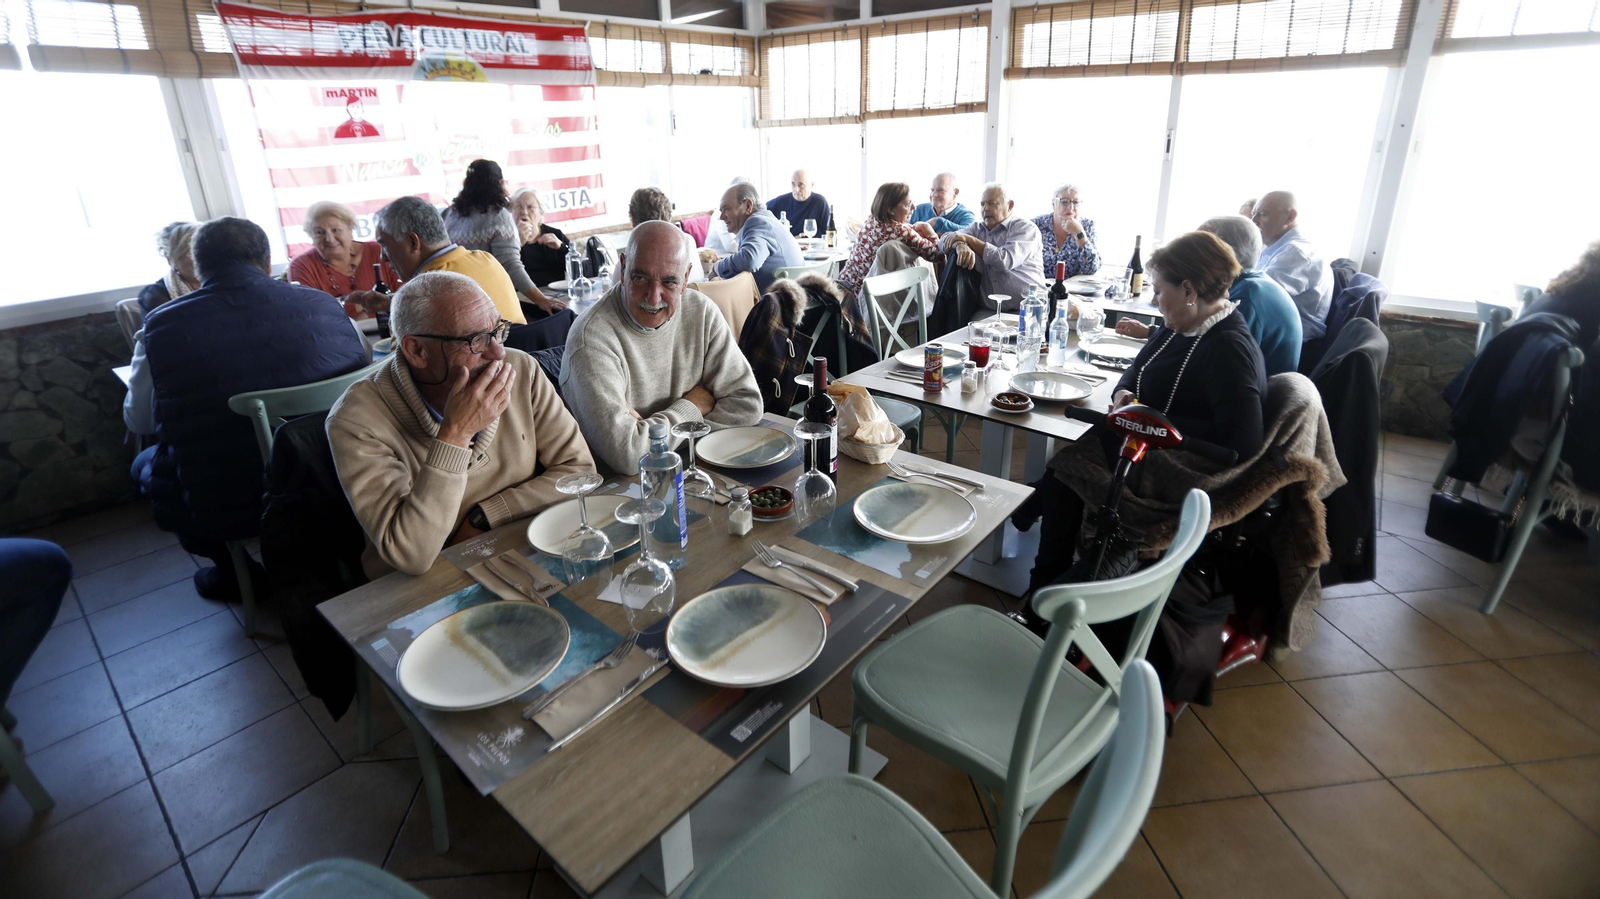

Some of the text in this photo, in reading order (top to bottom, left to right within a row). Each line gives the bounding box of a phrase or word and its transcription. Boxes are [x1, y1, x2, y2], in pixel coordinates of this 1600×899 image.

[338, 23, 530, 54] PEÑA CULTURAL
[542, 189, 591, 210] RISTA
[1115, 416, 1168, 438] STERLING
[477, 732, 491, 745] LOS
[487, 742, 510, 765] PULPOS
